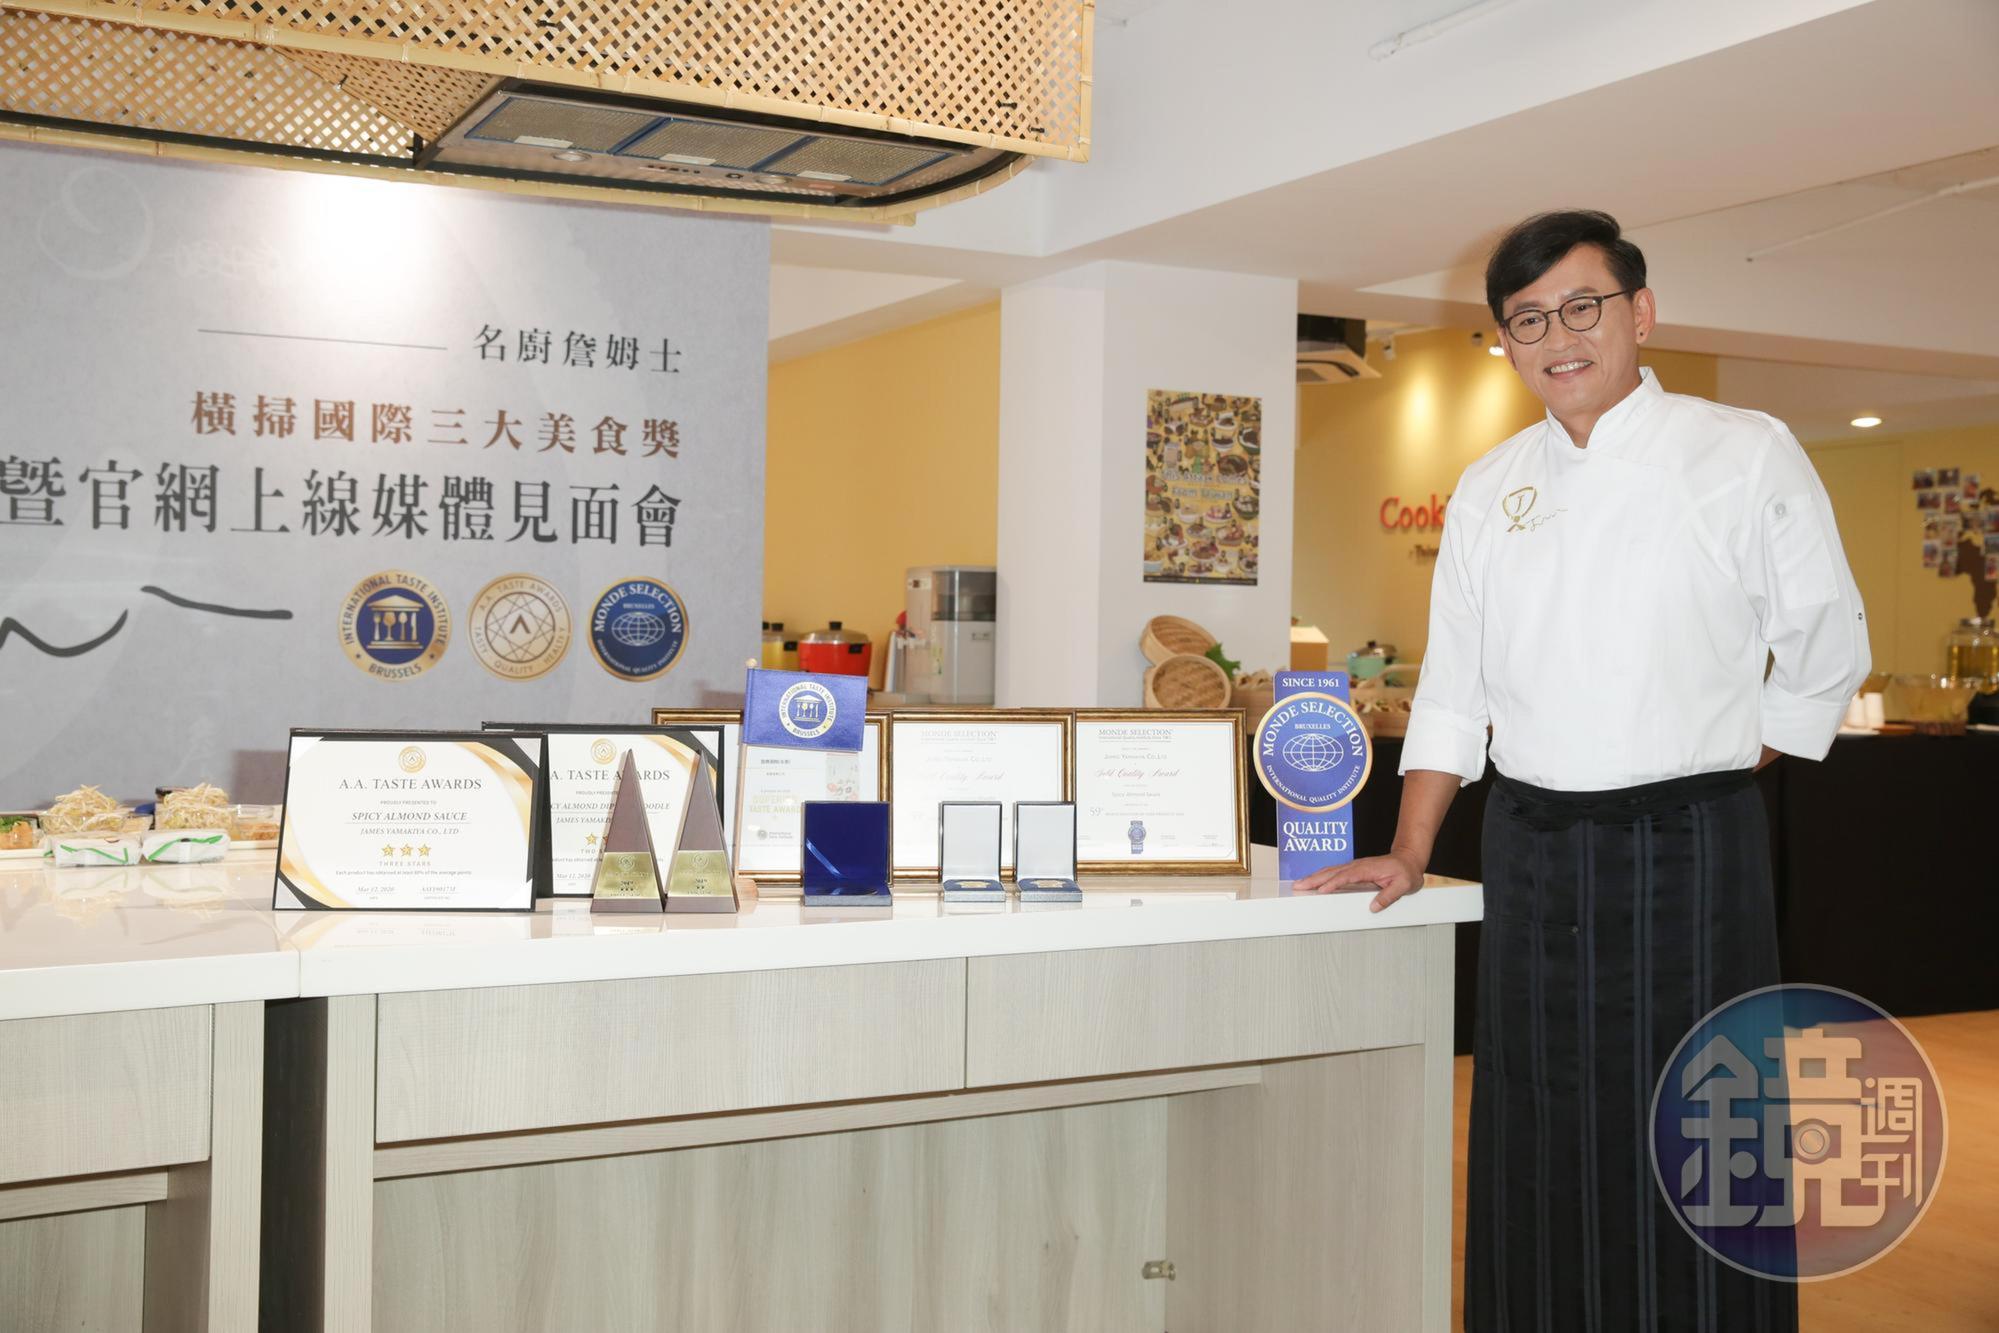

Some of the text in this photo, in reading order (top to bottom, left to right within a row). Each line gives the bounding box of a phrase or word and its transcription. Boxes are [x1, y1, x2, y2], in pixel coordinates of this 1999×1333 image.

[473, 324, 682, 373] 名廚詹姆士
[191, 391, 681, 459] 橫掃國際三大美食獎
[0, 455, 682, 548] 暨官網上線媒體見面會
[1379, 494, 1446, 530] Cook
[342, 574, 392, 646] INTERNATIONAL
[395, 573, 428, 593] TASTE
[427, 591, 449, 646] INSTITUTE
[594, 583, 682, 633] MONDE SELECTION
[368, 662, 423, 679] BRUSSELS
[1282, 677, 1340, 688] SINCE 1961
[1262, 701, 1363, 757] MONDE SELECTION
[1294, 722, 1331, 731] BRUXELLES
[338, 777, 483, 790] A.A. TASTE AWARDS
[567, 769, 610, 781] TASTE
[612, 769, 671, 781] AARDS
[1266, 764, 1361, 804] INTERNATIONAL QUALITY INSTITUTE
[562, 802, 599, 811] ALMOND
[351, 811, 468, 822] SPICY ALMOND SAUCE
[360, 827, 385, 836] JAMES
[386, 827, 426, 836] YAMAKIYA
[443, 827, 460, 836] LTD
[1283, 820, 1349, 839] QUALITY
[1284, 837, 1348, 852] AWARD
[379, 860, 432, 868] THREE STARS
